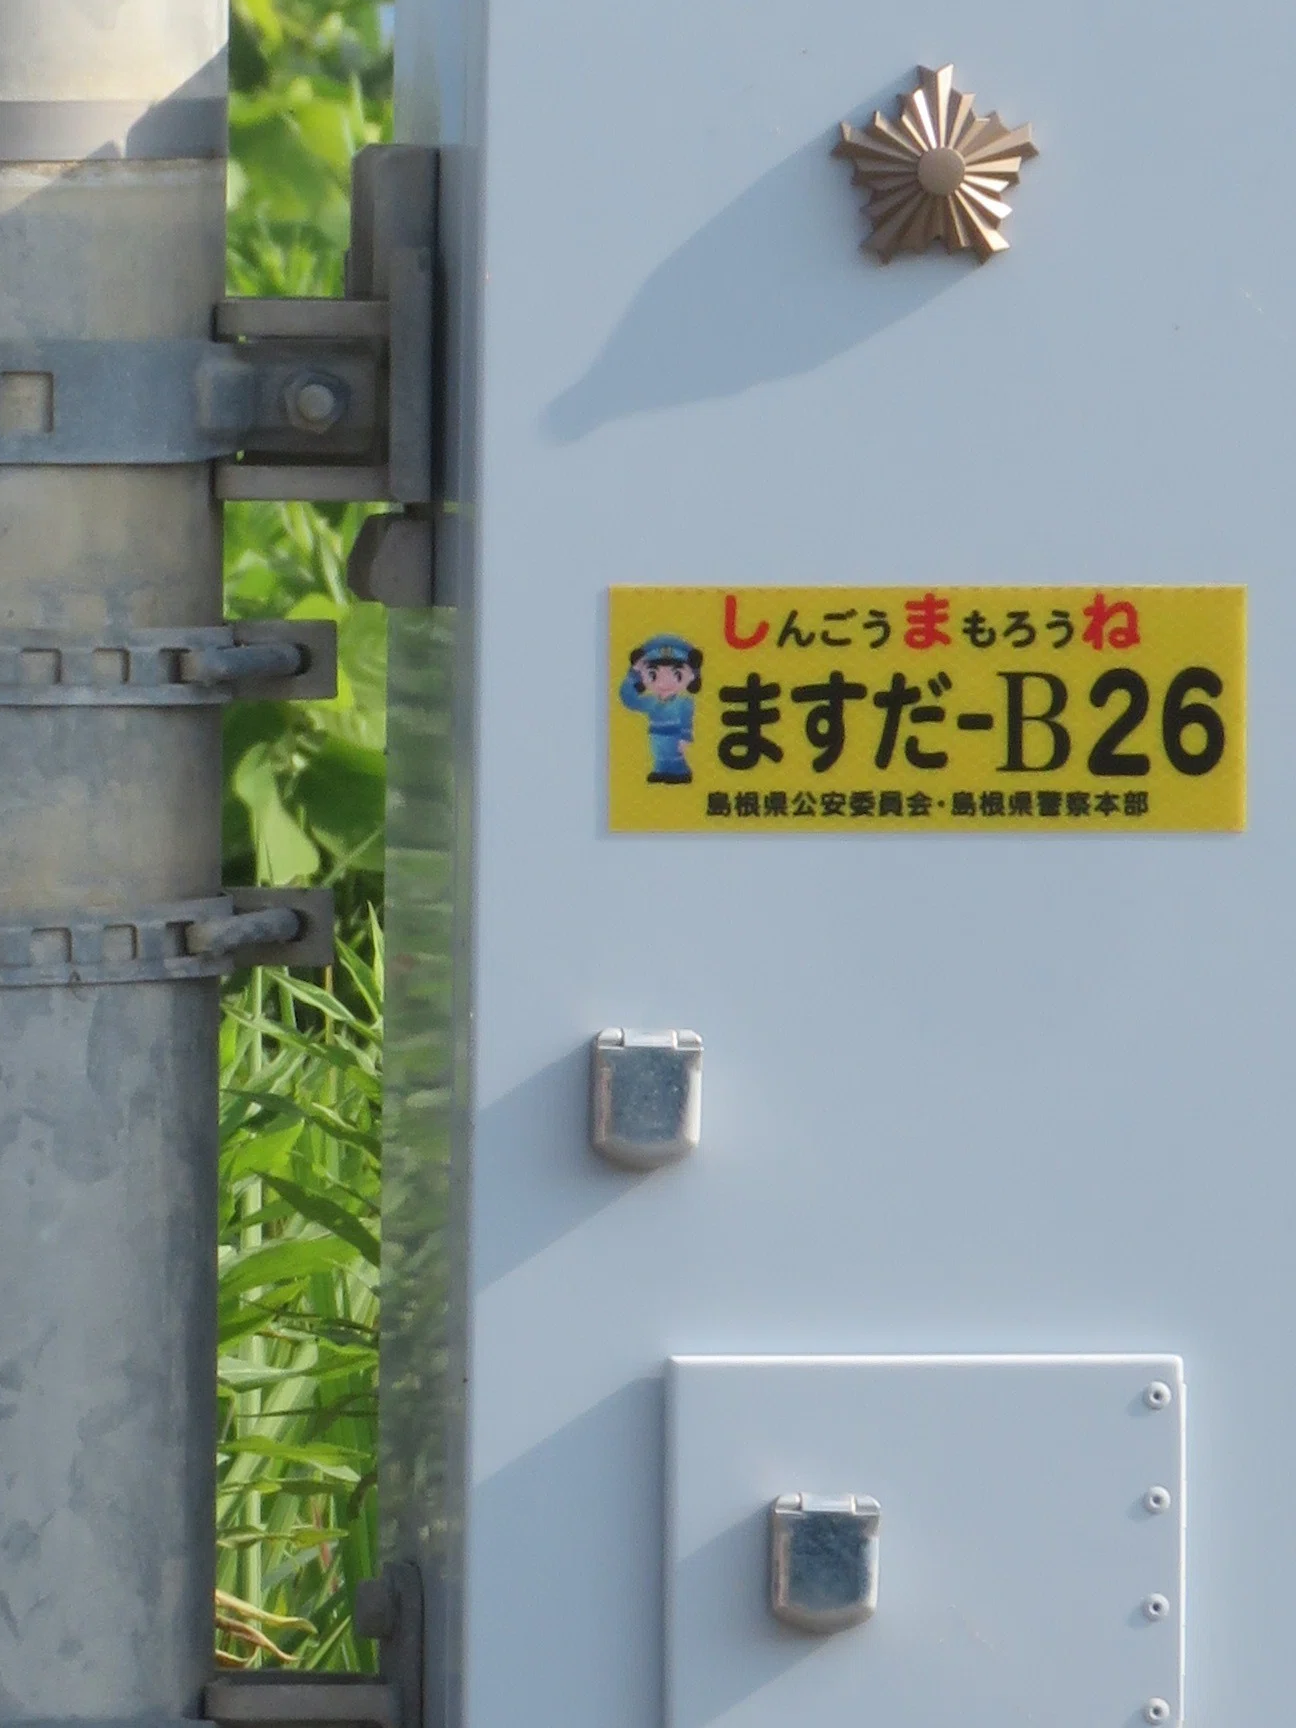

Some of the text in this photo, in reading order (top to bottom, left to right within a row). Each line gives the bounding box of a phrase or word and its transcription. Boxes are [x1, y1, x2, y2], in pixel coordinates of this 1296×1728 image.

[724, 593, 1141, 650] しんごうまもろうね
[707, 791, 1150, 818] 島根県公安委員会・島根県警察本部
